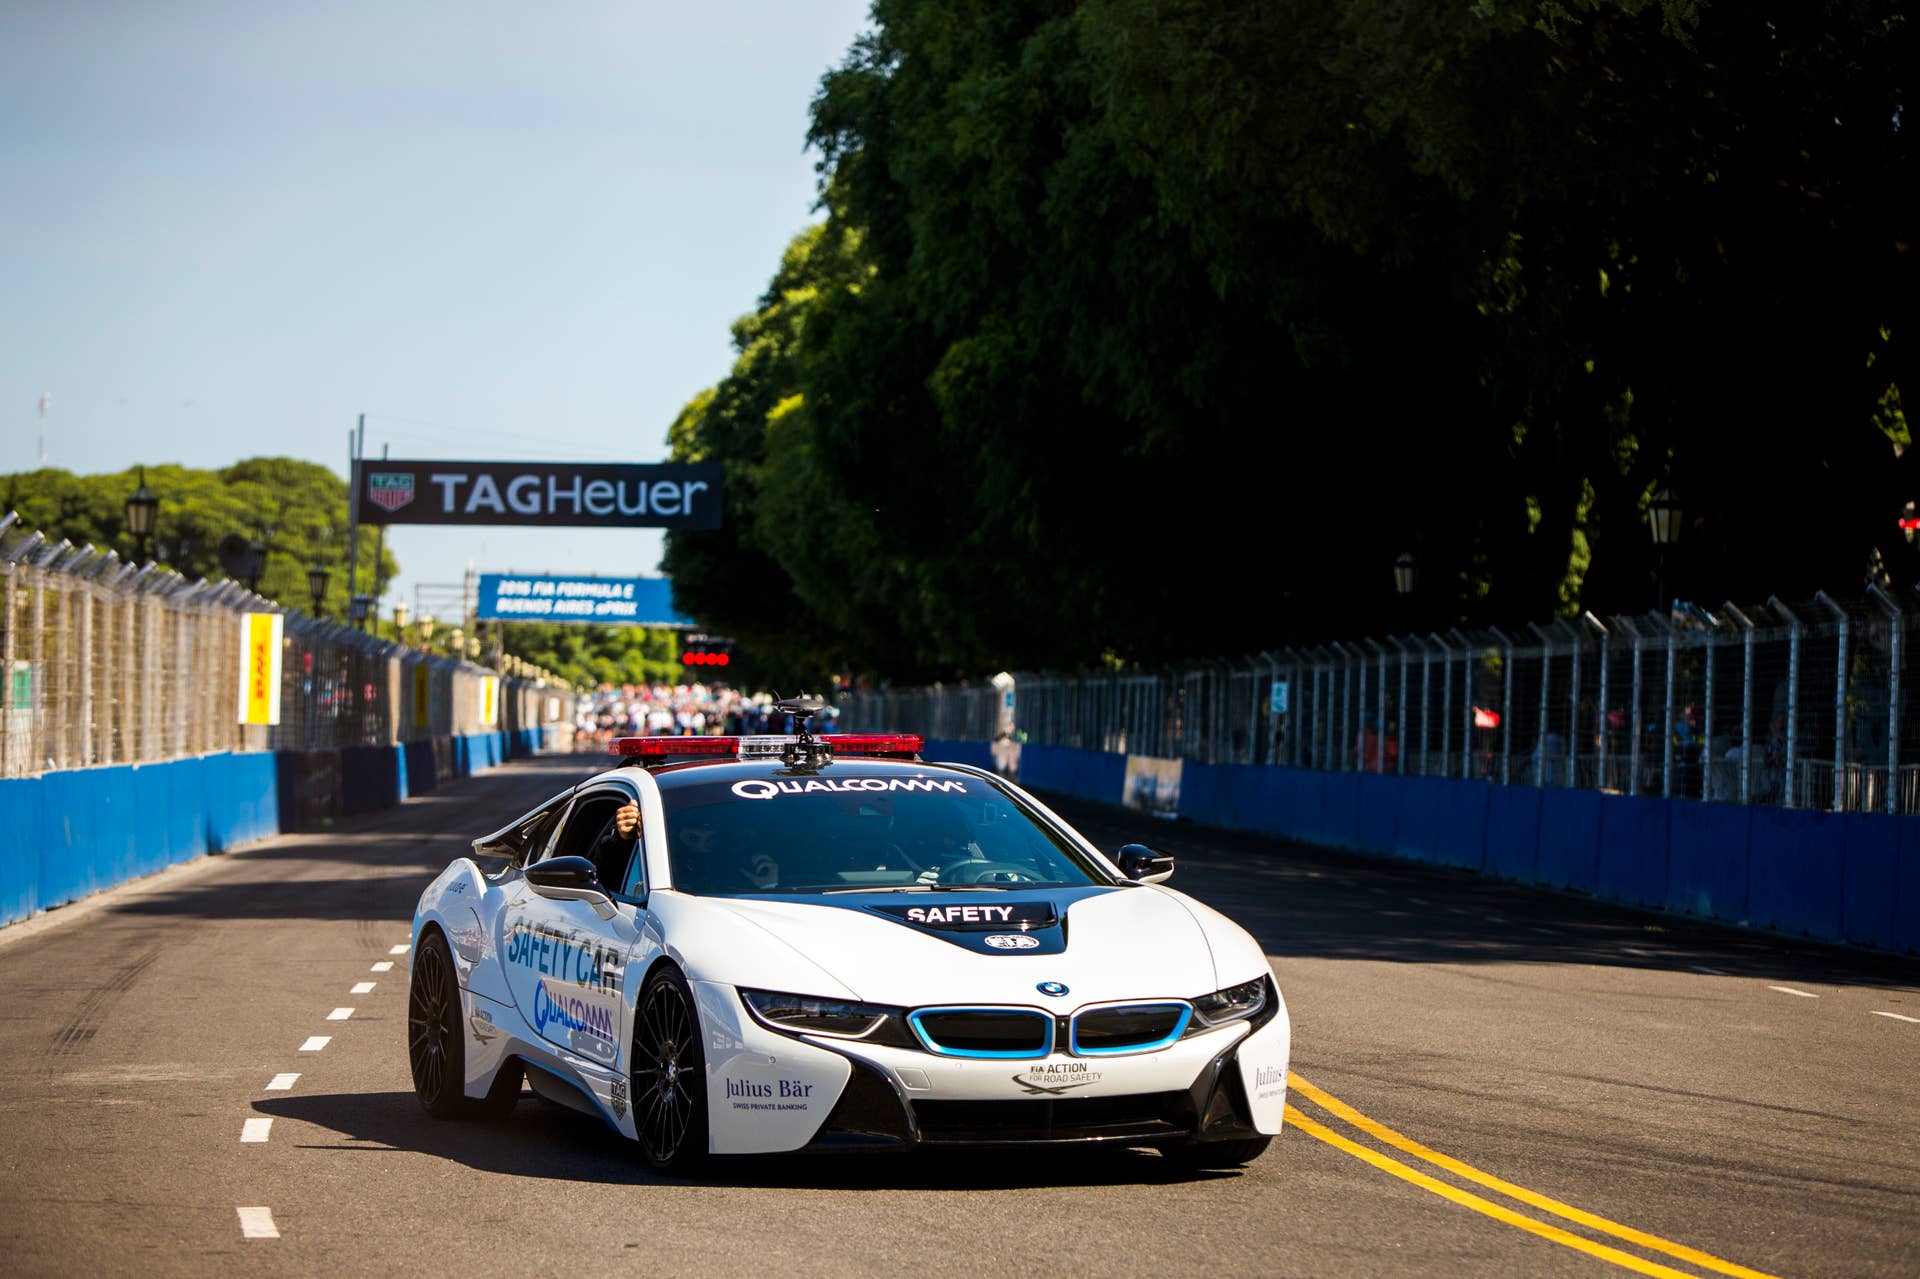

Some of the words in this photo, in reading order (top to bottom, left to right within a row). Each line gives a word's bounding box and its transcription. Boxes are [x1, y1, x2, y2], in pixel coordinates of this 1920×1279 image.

[430, 473, 708, 516] TAGHeuer
[731, 779, 967, 799] QUALCOMM
[907, 906, 1013, 923] SAFETY
[508, 916, 577, 980] SAFETY
[576, 937, 619, 997] CAR
[534, 979, 613, 1041] QUALCOMM
[1044, 1074, 1068, 1083] ROAD
[1070, 1072, 1102, 1081] SAFETY
[1047, 1063, 1087, 1074] ACTION
[726, 1078, 773, 1099] Julius
[780, 1080, 813, 1098] Bär
